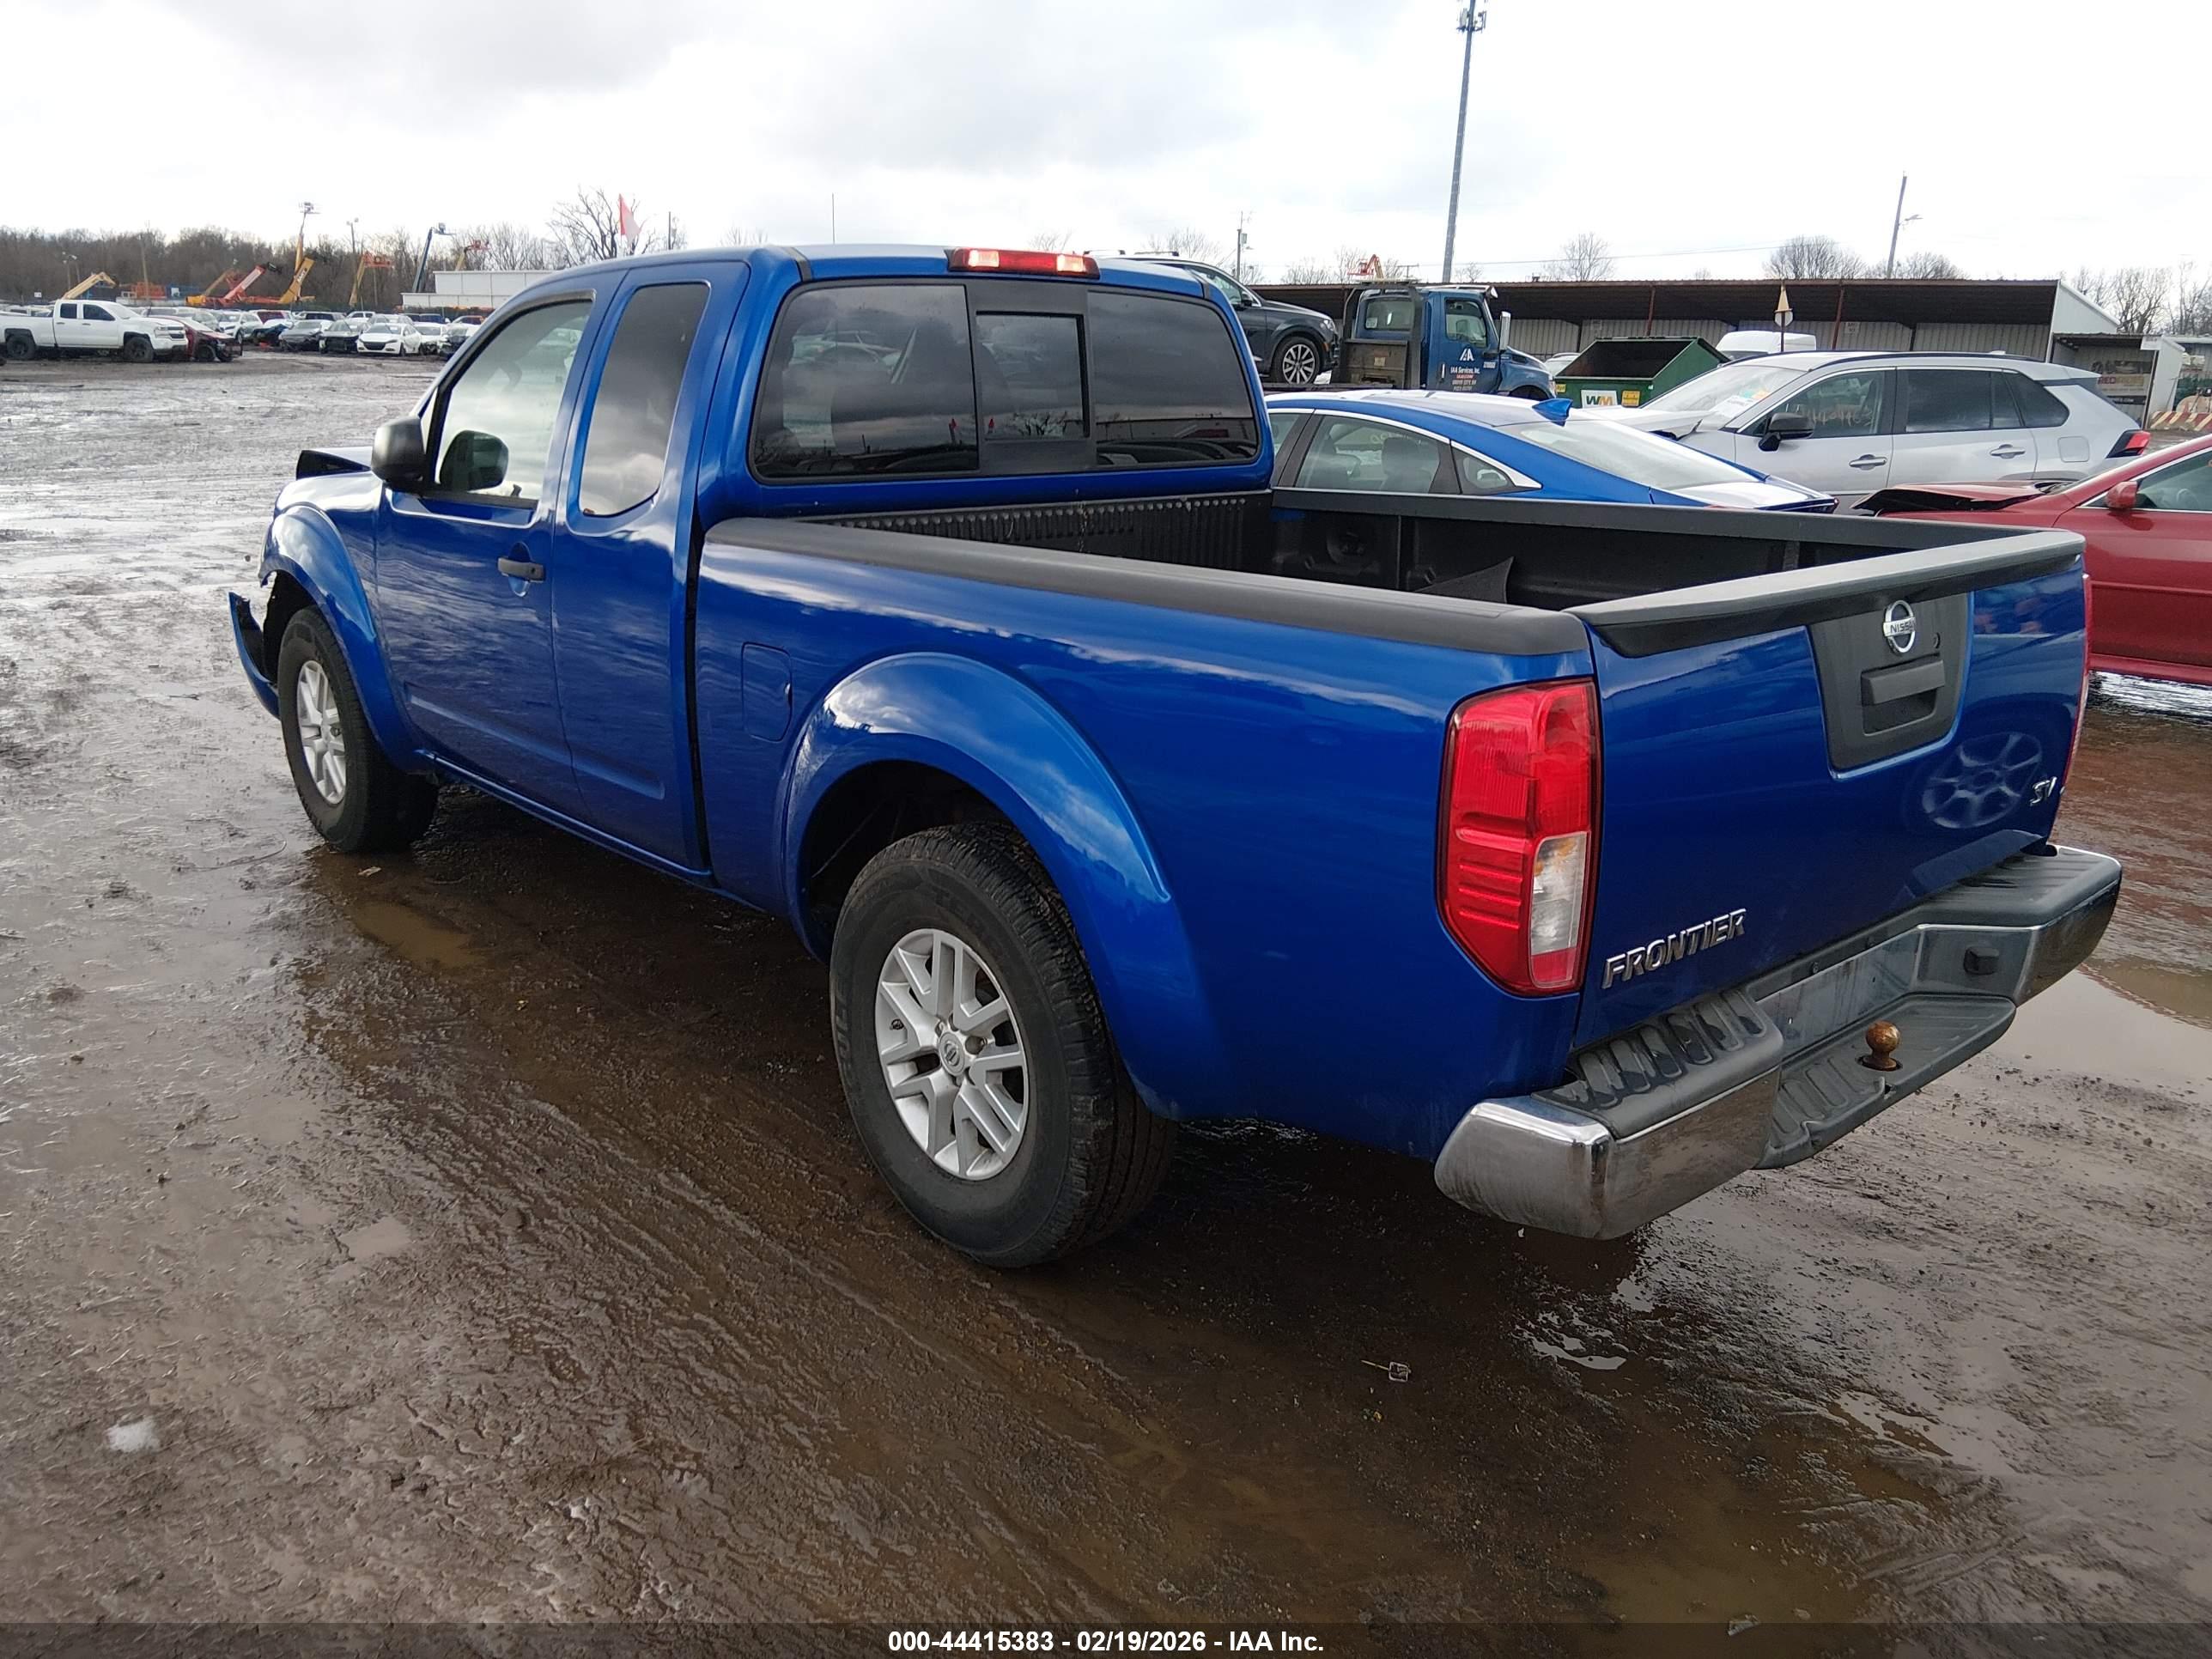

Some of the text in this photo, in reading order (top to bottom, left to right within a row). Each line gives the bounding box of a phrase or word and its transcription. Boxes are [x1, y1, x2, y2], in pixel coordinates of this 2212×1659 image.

[1586, 395, 1613, 406] WM
[2029, 775, 2058, 807] SV
[1601, 908, 1747, 990] FRONTIER
